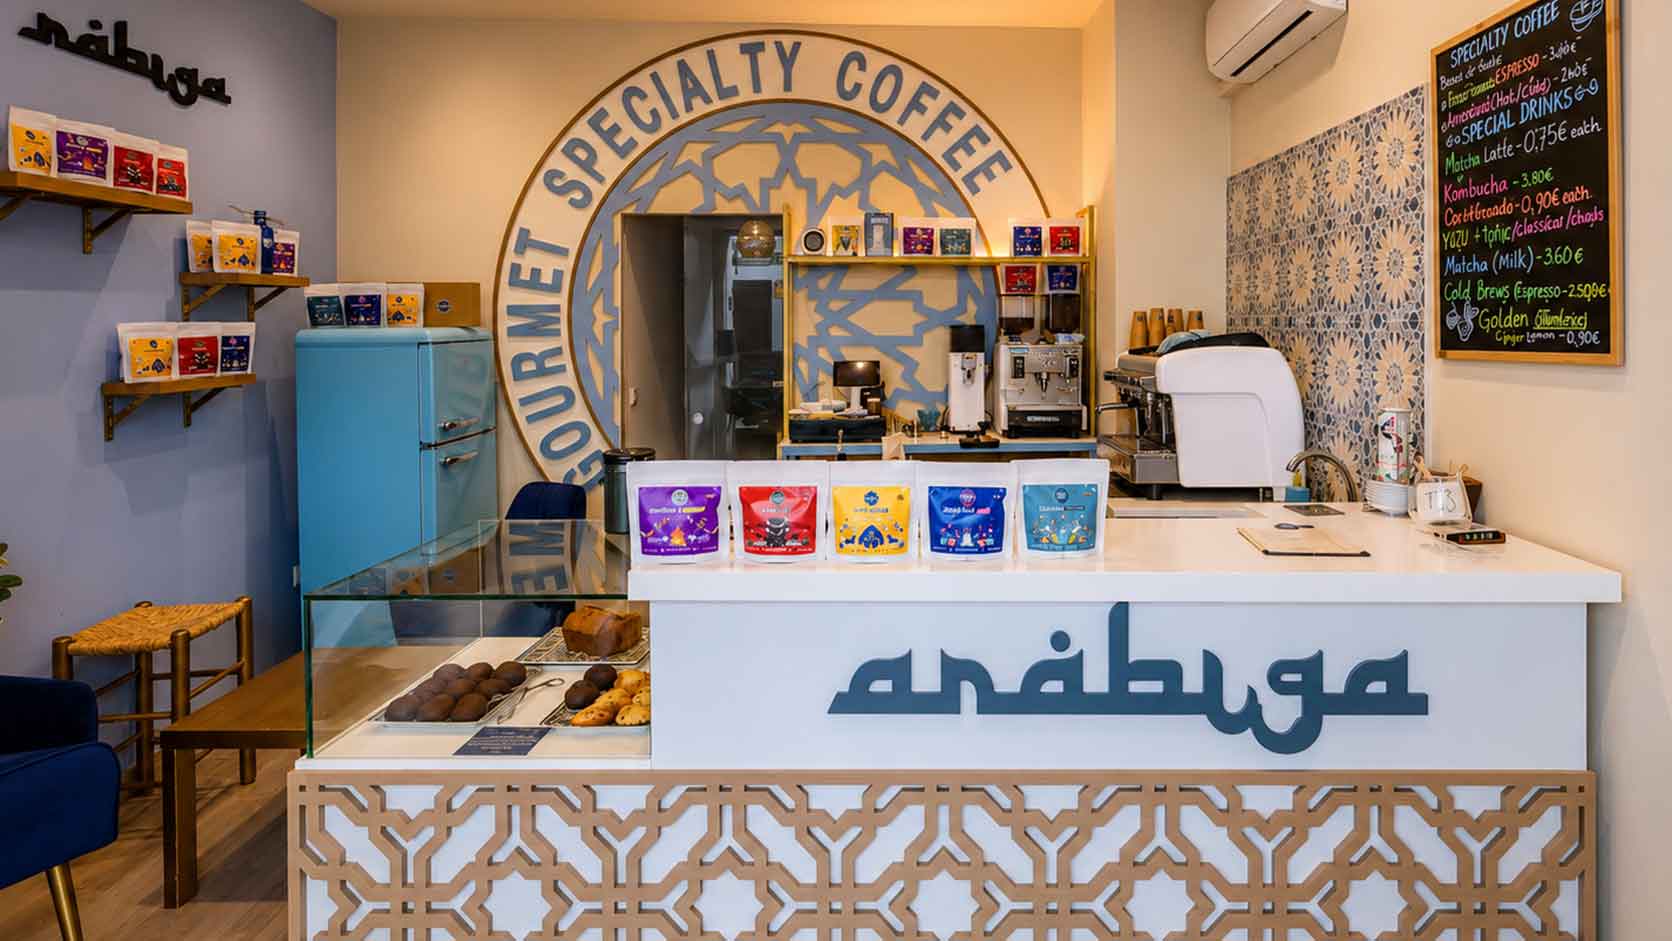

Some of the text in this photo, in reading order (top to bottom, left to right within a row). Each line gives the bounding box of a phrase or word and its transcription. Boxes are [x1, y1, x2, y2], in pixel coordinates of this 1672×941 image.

[1450, 23, 1509, 68] SPECIALTY
[1514, 0, 1560, 38] COFFEE
[1461, 109, 1516, 145] SPECIAL
[1519, 87, 1573, 125] DRINKS
[1484, 136, 1514, 163] Latte
[1444, 175, 1508, 204] Kombucha
[507, 41, 1013, 491] GOURMET SPECIALTY COFFEE
[1444, 254, 1488, 275] Matcha
[1492, 246, 1534, 275] (Milk)
[1444, 280, 1471, 300] Cold
[1477, 280, 1510, 303] Brews
[1478, 308, 1528, 333] Golden
